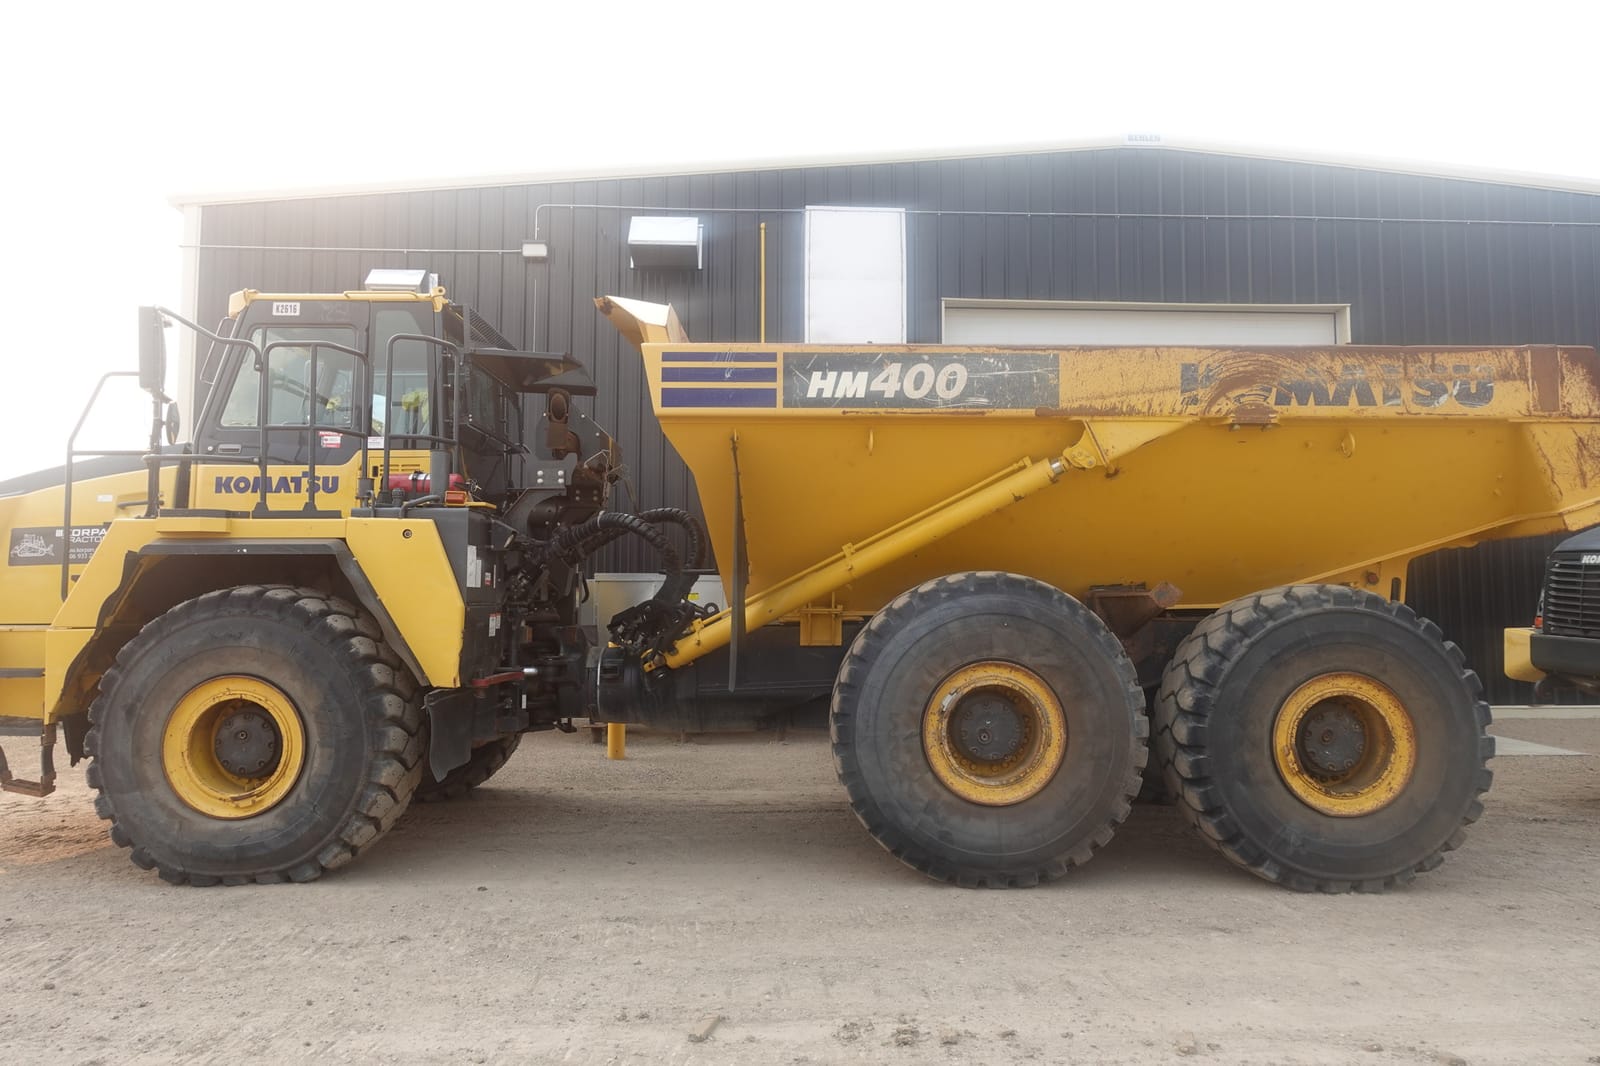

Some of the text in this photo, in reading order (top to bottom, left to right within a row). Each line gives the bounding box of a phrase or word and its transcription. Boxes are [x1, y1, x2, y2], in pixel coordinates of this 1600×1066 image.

[806, 362, 968, 399] HM400
[1180, 363, 1495, 408] KMATSU
[214, 471, 340, 494] KOMATSU
[71, 528, 107, 537] ORPA
